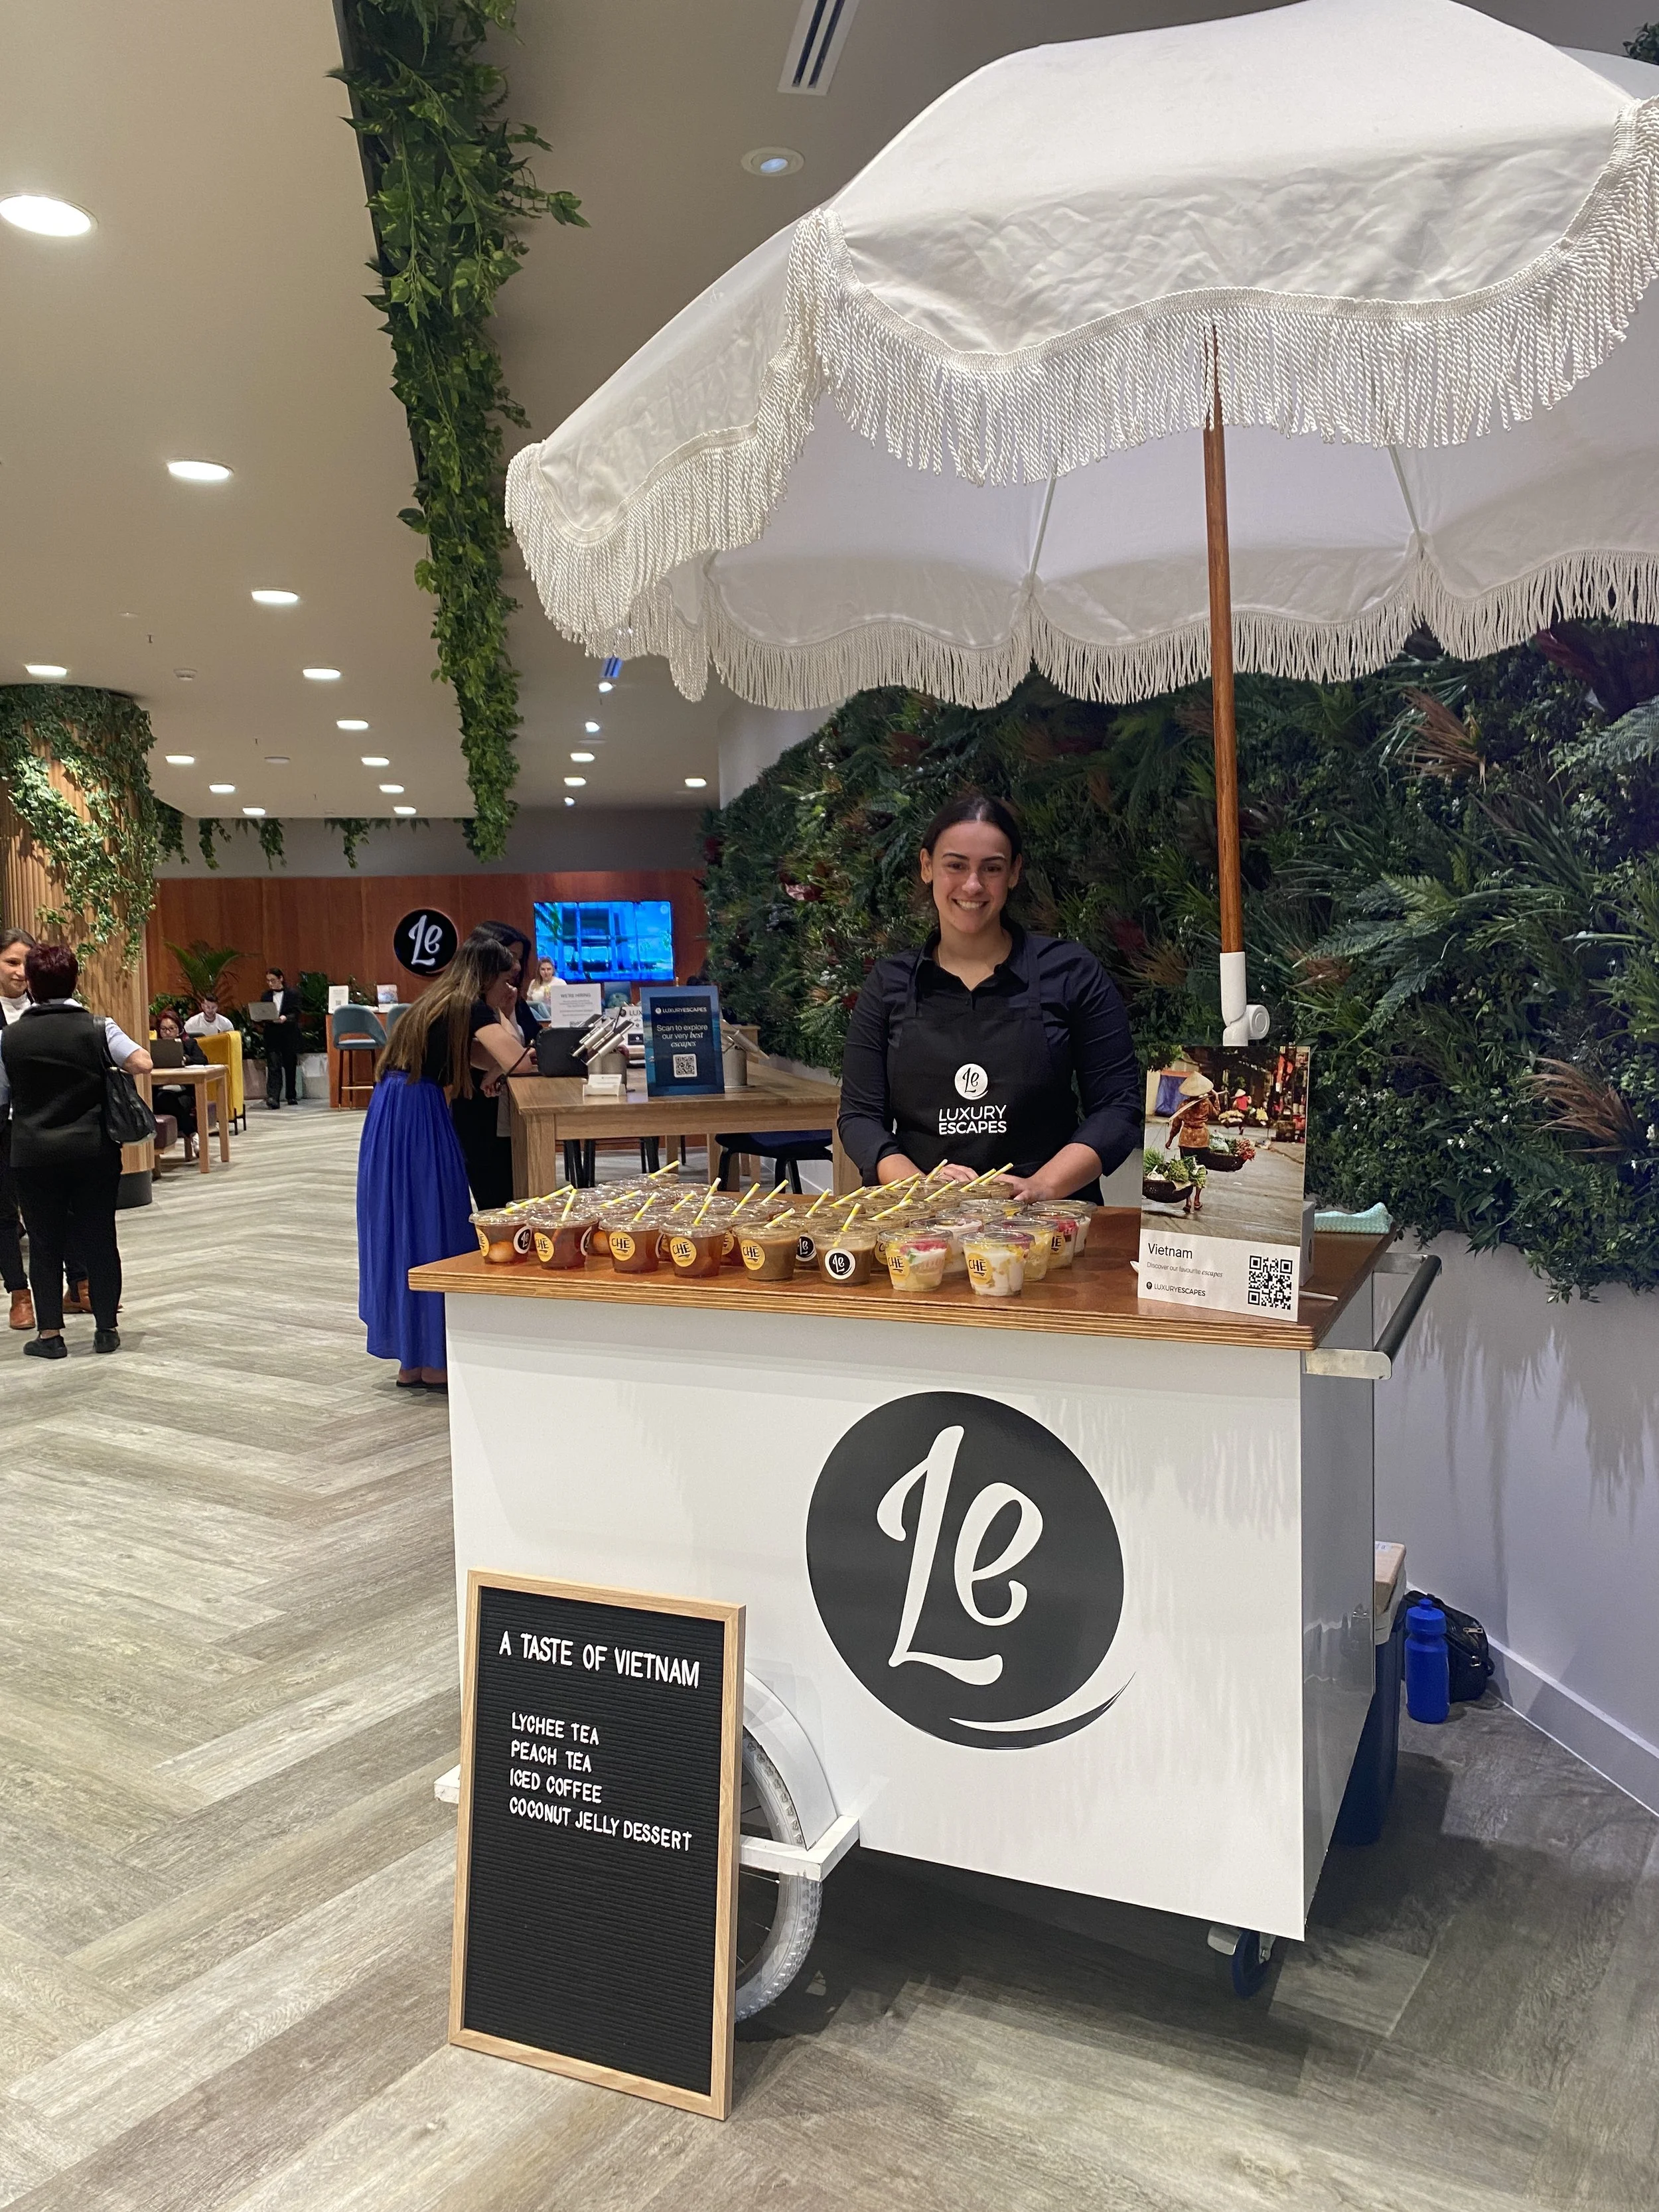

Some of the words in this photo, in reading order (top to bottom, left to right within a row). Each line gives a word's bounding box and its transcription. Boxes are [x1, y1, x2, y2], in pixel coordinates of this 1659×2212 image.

[408, 915, 443, 966] Le
[962, 1067, 979, 1093] Le
[938, 1104, 1007, 1122] LUXURY
[938, 1120, 1007, 1135] ESCAPES
[832, 1254, 845, 1273] Le
[1148, 1242, 1192, 1259] Vietnam
[1147, 1262, 1169, 1270] Discover
[1154, 1284, 1206, 1297] LUXURYESCAPES
[876, 1425, 1043, 1686] Le
[499, 1631, 512, 1656] A
[520, 1633, 573, 1666] TASTE
[582, 1643, 607, 1671] OF
[614, 1647, 700, 1688] VIETNAM
[511, 1711, 565, 1739] LYCHEE
[571, 1722, 600, 1745] TEA
[510, 1739, 557, 1765] PEACH
[565, 1751, 592, 1773] TEA
[510, 1768, 541, 1790] ICED
[545, 1775, 603, 1804] COFFEE
[509, 1796, 571, 1826] COCONUT
[575, 1810, 620, 1836] JELLY
[623, 1820, 692, 1852] DESSERT
